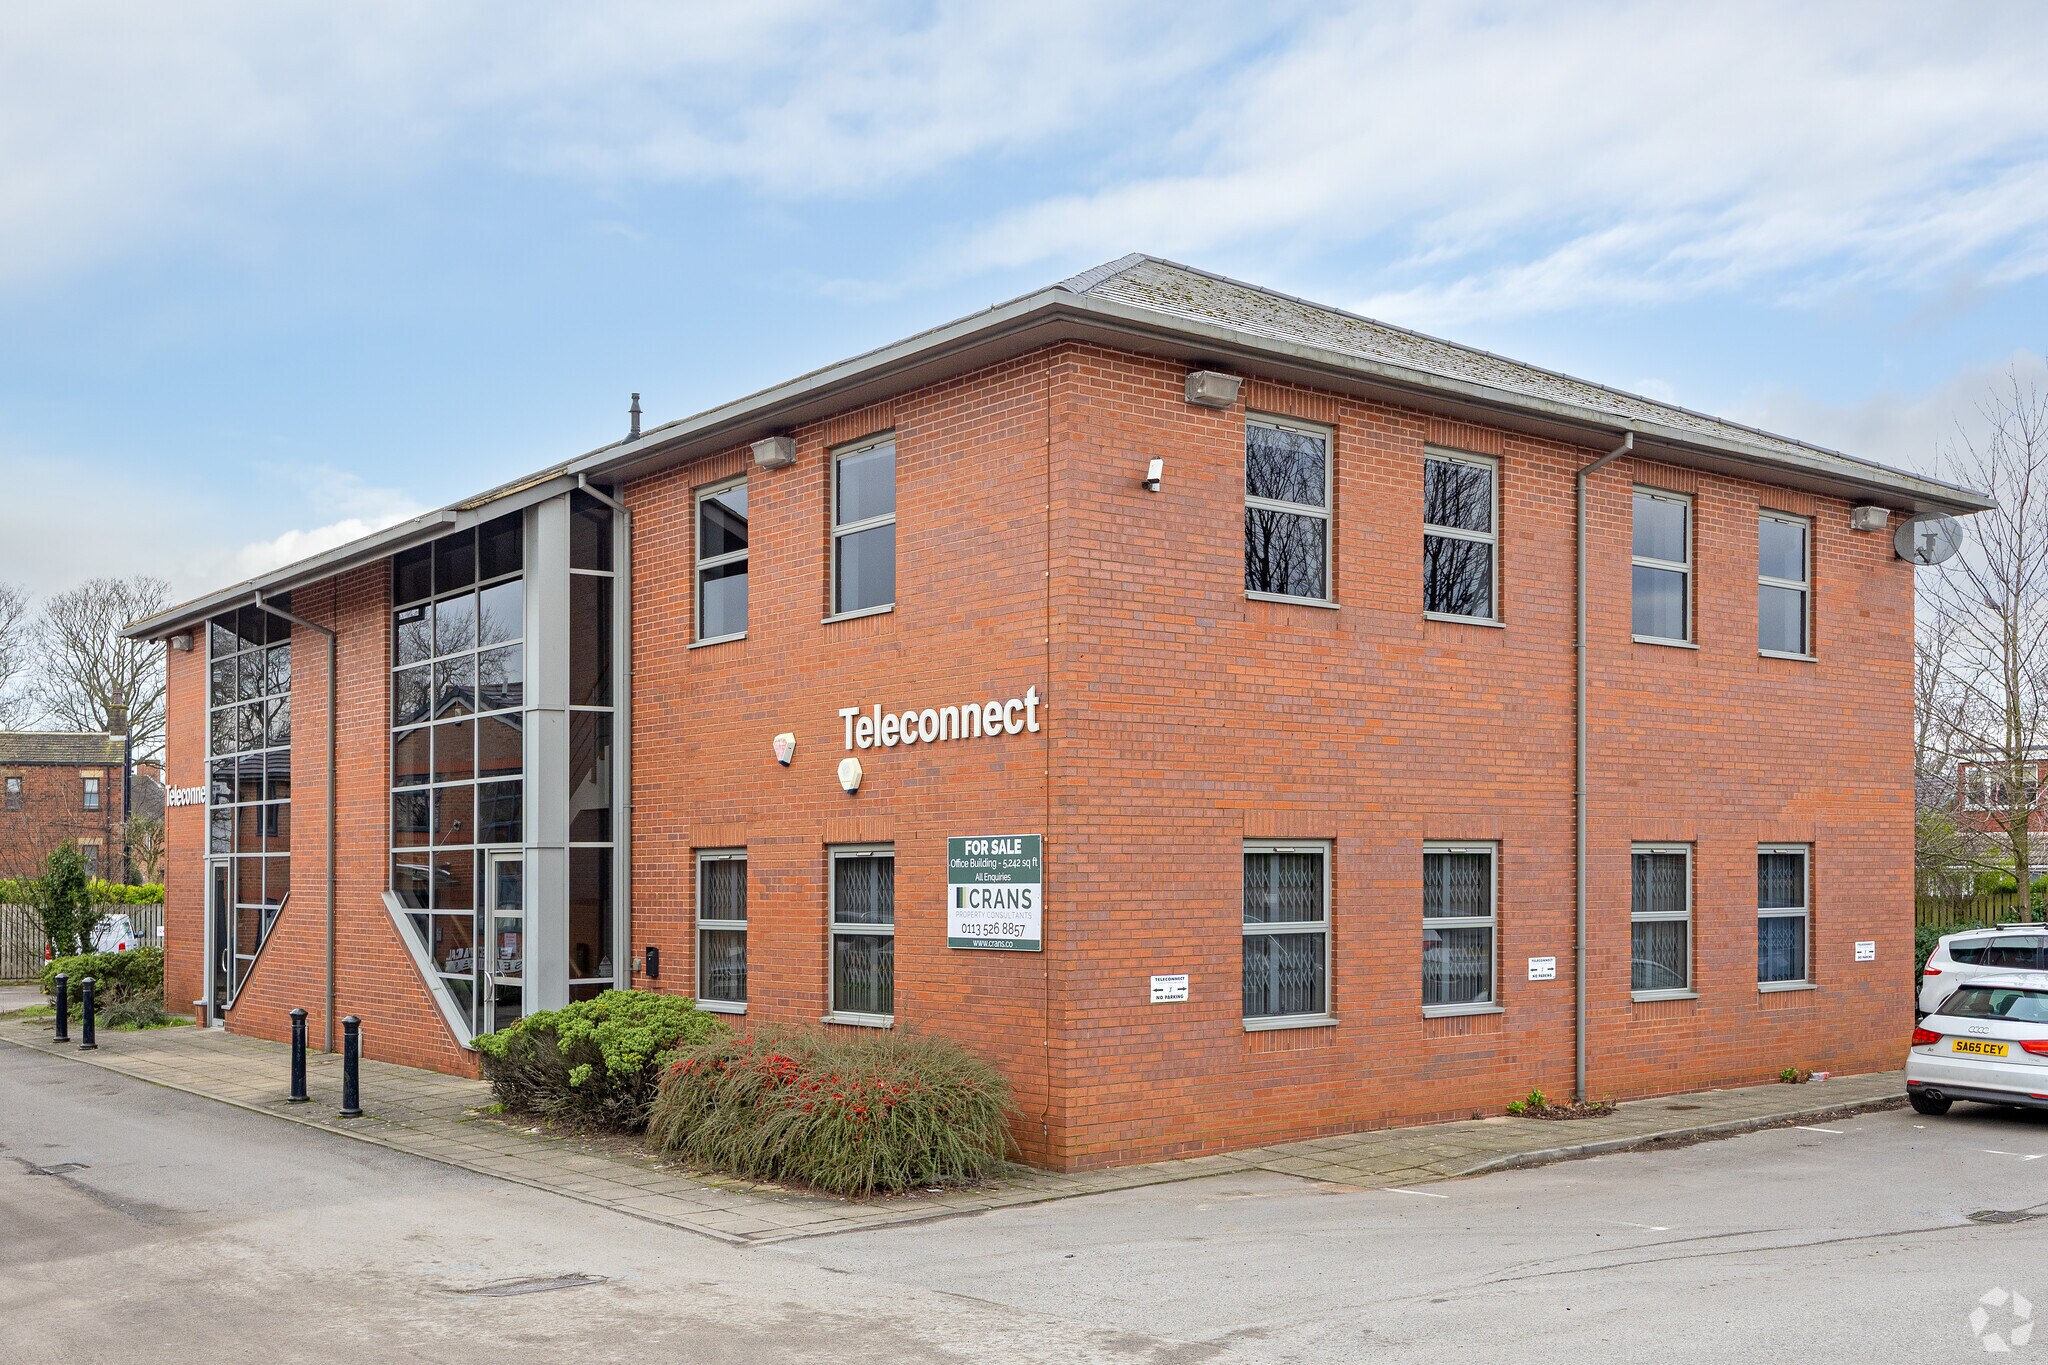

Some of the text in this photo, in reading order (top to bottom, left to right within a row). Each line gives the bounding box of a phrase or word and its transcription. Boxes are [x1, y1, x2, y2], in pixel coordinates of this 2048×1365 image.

[838, 685, 1040, 750] Teleconnect
[965, 839, 1022, 855] FOR SALE
[950, 858, 969, 869] Office
[970, 857, 997, 869] Building
[1022, 859, 1031, 869] sq
[1032, 857, 1038, 867] ft
[975, 872, 1012, 883] All Enquiries
[969, 888, 1032, 909] CRANS
[987, 911, 1033, 920] CONSULTANTS
[961, 922, 1026, 938] 0113 526 8857
[973, 940, 1014, 948] www.crans.co
[1956, 1041, 2004, 1055] SA65 CEY
